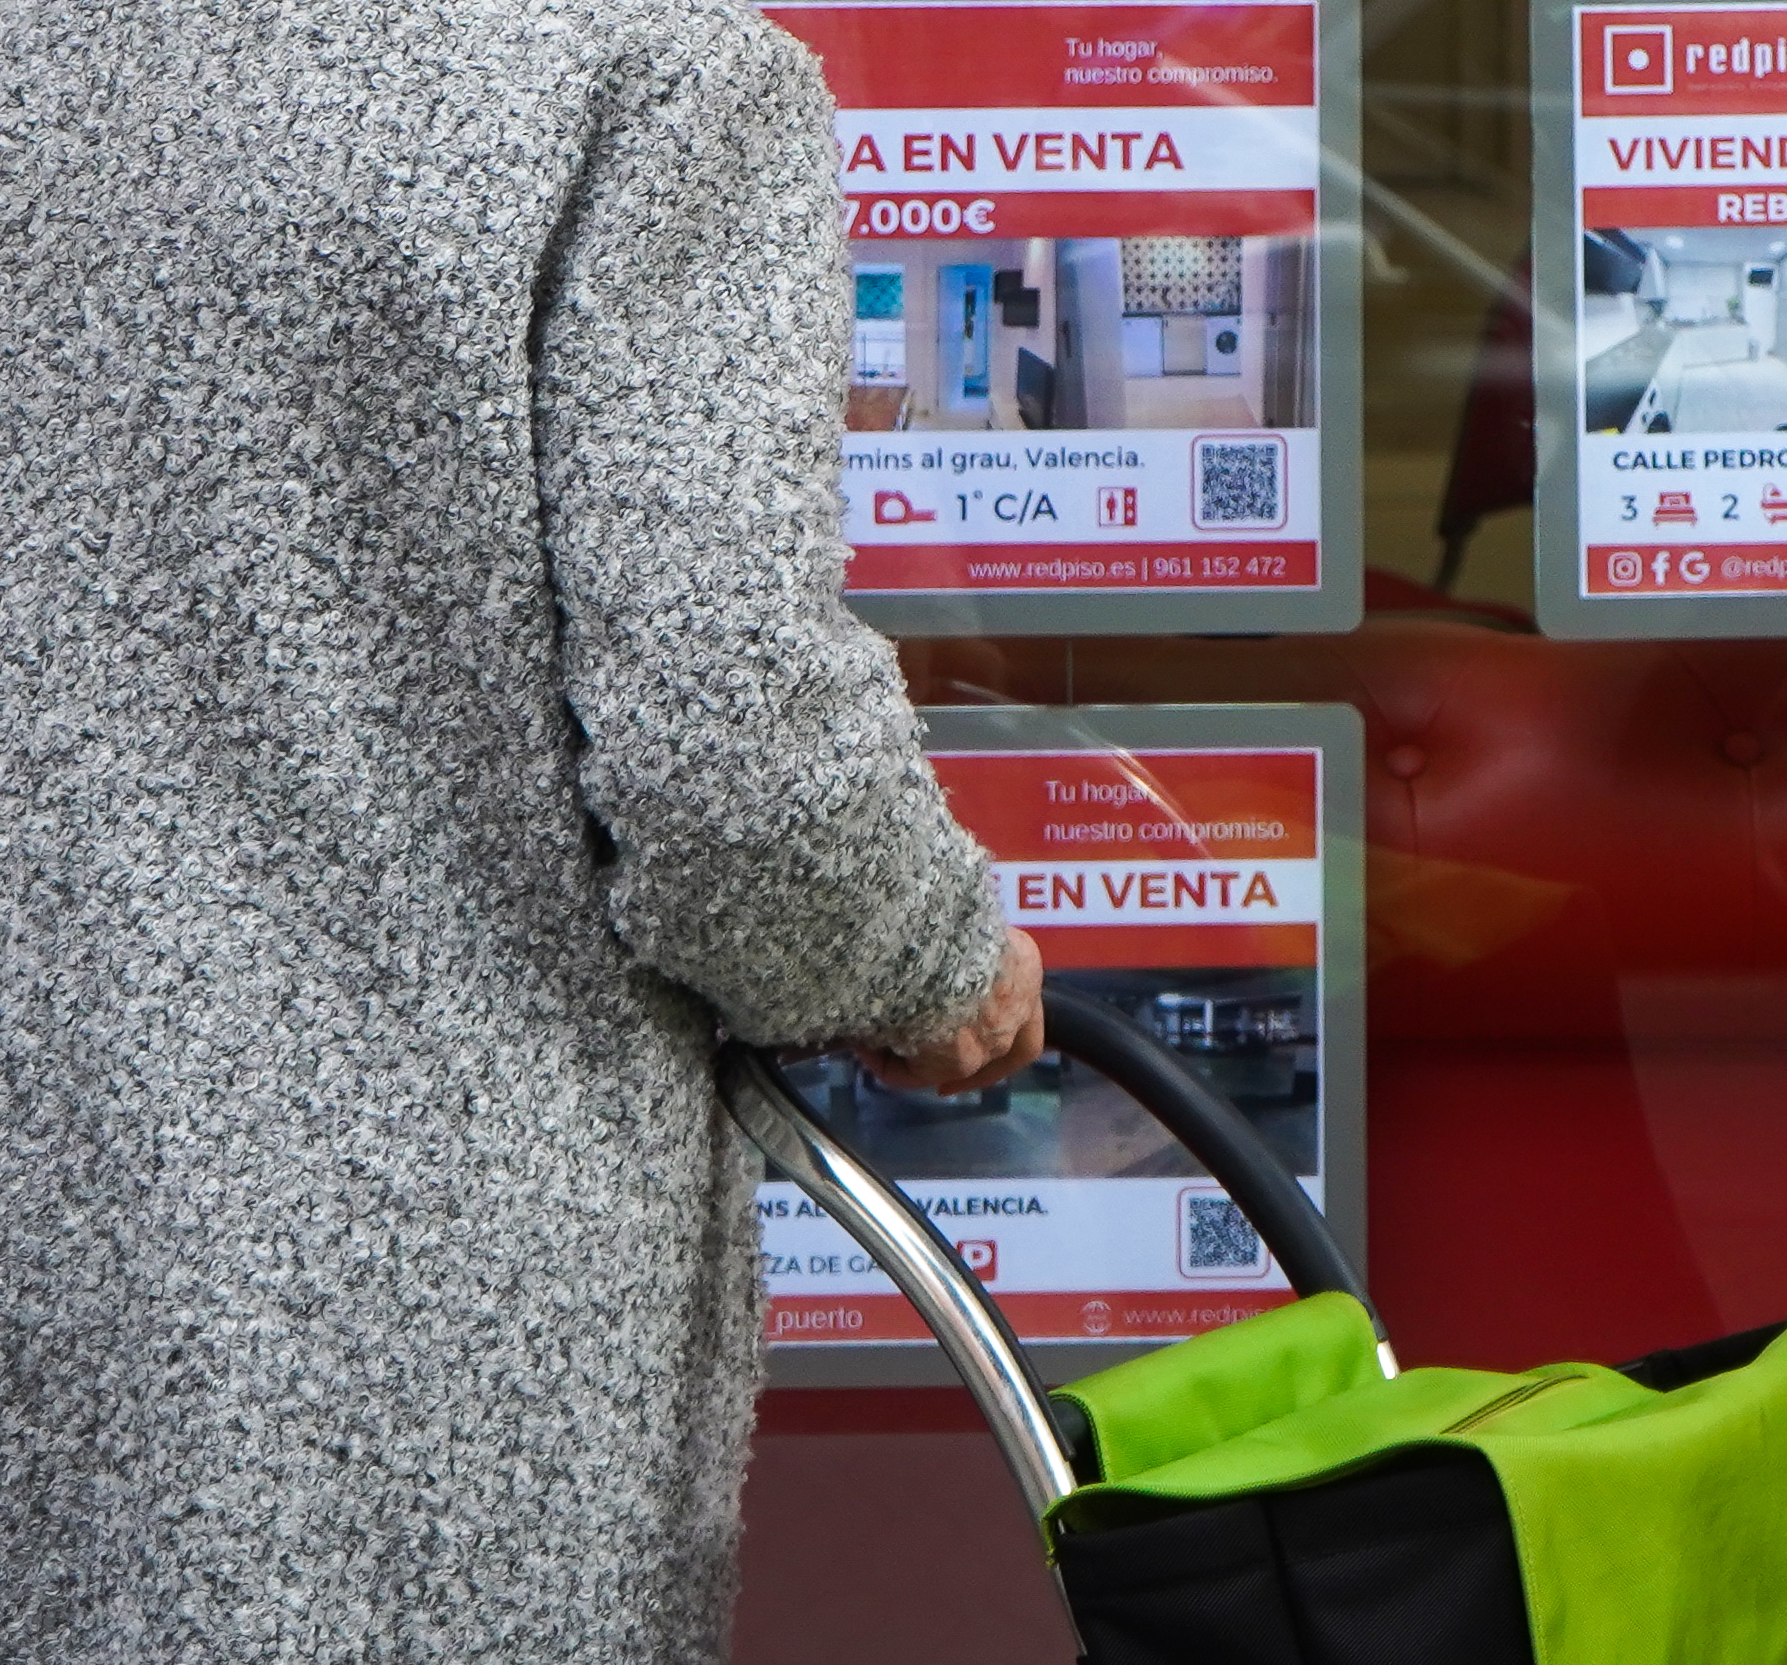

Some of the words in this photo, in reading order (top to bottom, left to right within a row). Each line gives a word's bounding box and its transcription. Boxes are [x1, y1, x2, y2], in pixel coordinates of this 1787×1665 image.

[903, 133, 976, 173] EN
[992, 132, 1184, 172] VENTA
[920, 447, 943, 469] al
[1017, 873, 1085, 911] EN
[1101, 871, 1277, 909] VENTA
